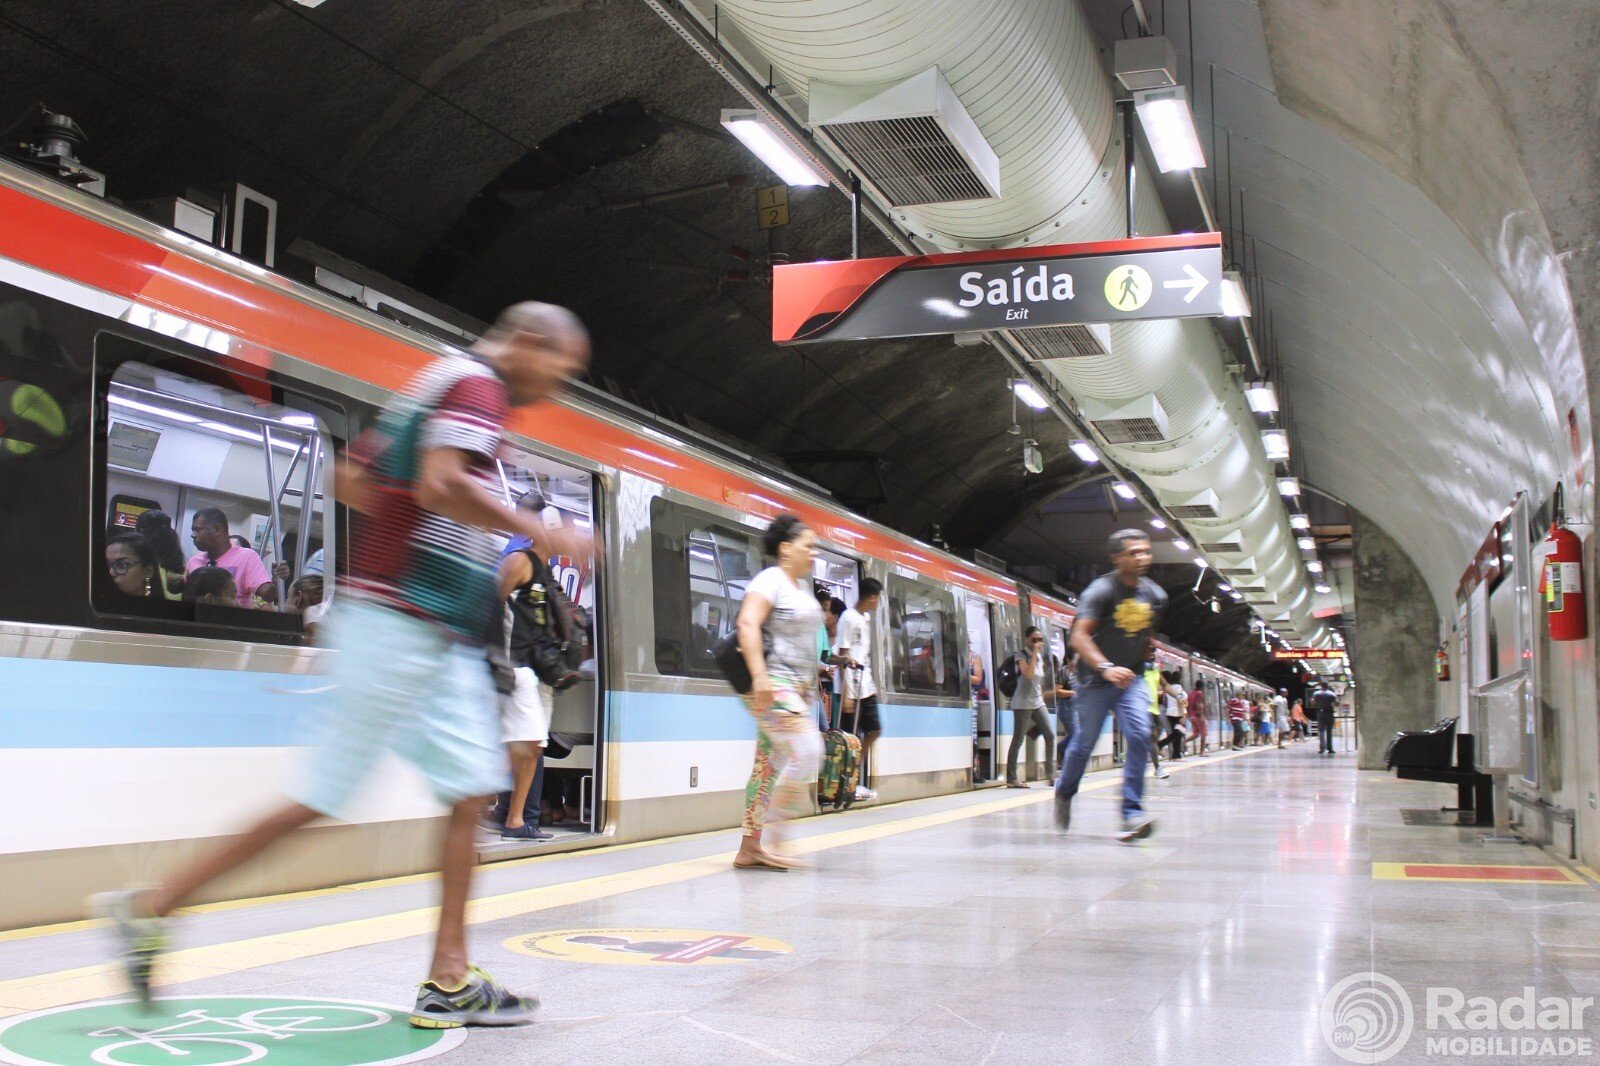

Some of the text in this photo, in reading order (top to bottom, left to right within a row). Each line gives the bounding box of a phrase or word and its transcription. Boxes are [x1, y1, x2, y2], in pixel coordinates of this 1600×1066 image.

[769, 188, 776, 203] 1
[770, 210, 779, 225] 2
[958, 264, 1075, 307] Saída
[1005, 308, 1030, 321] Exit
